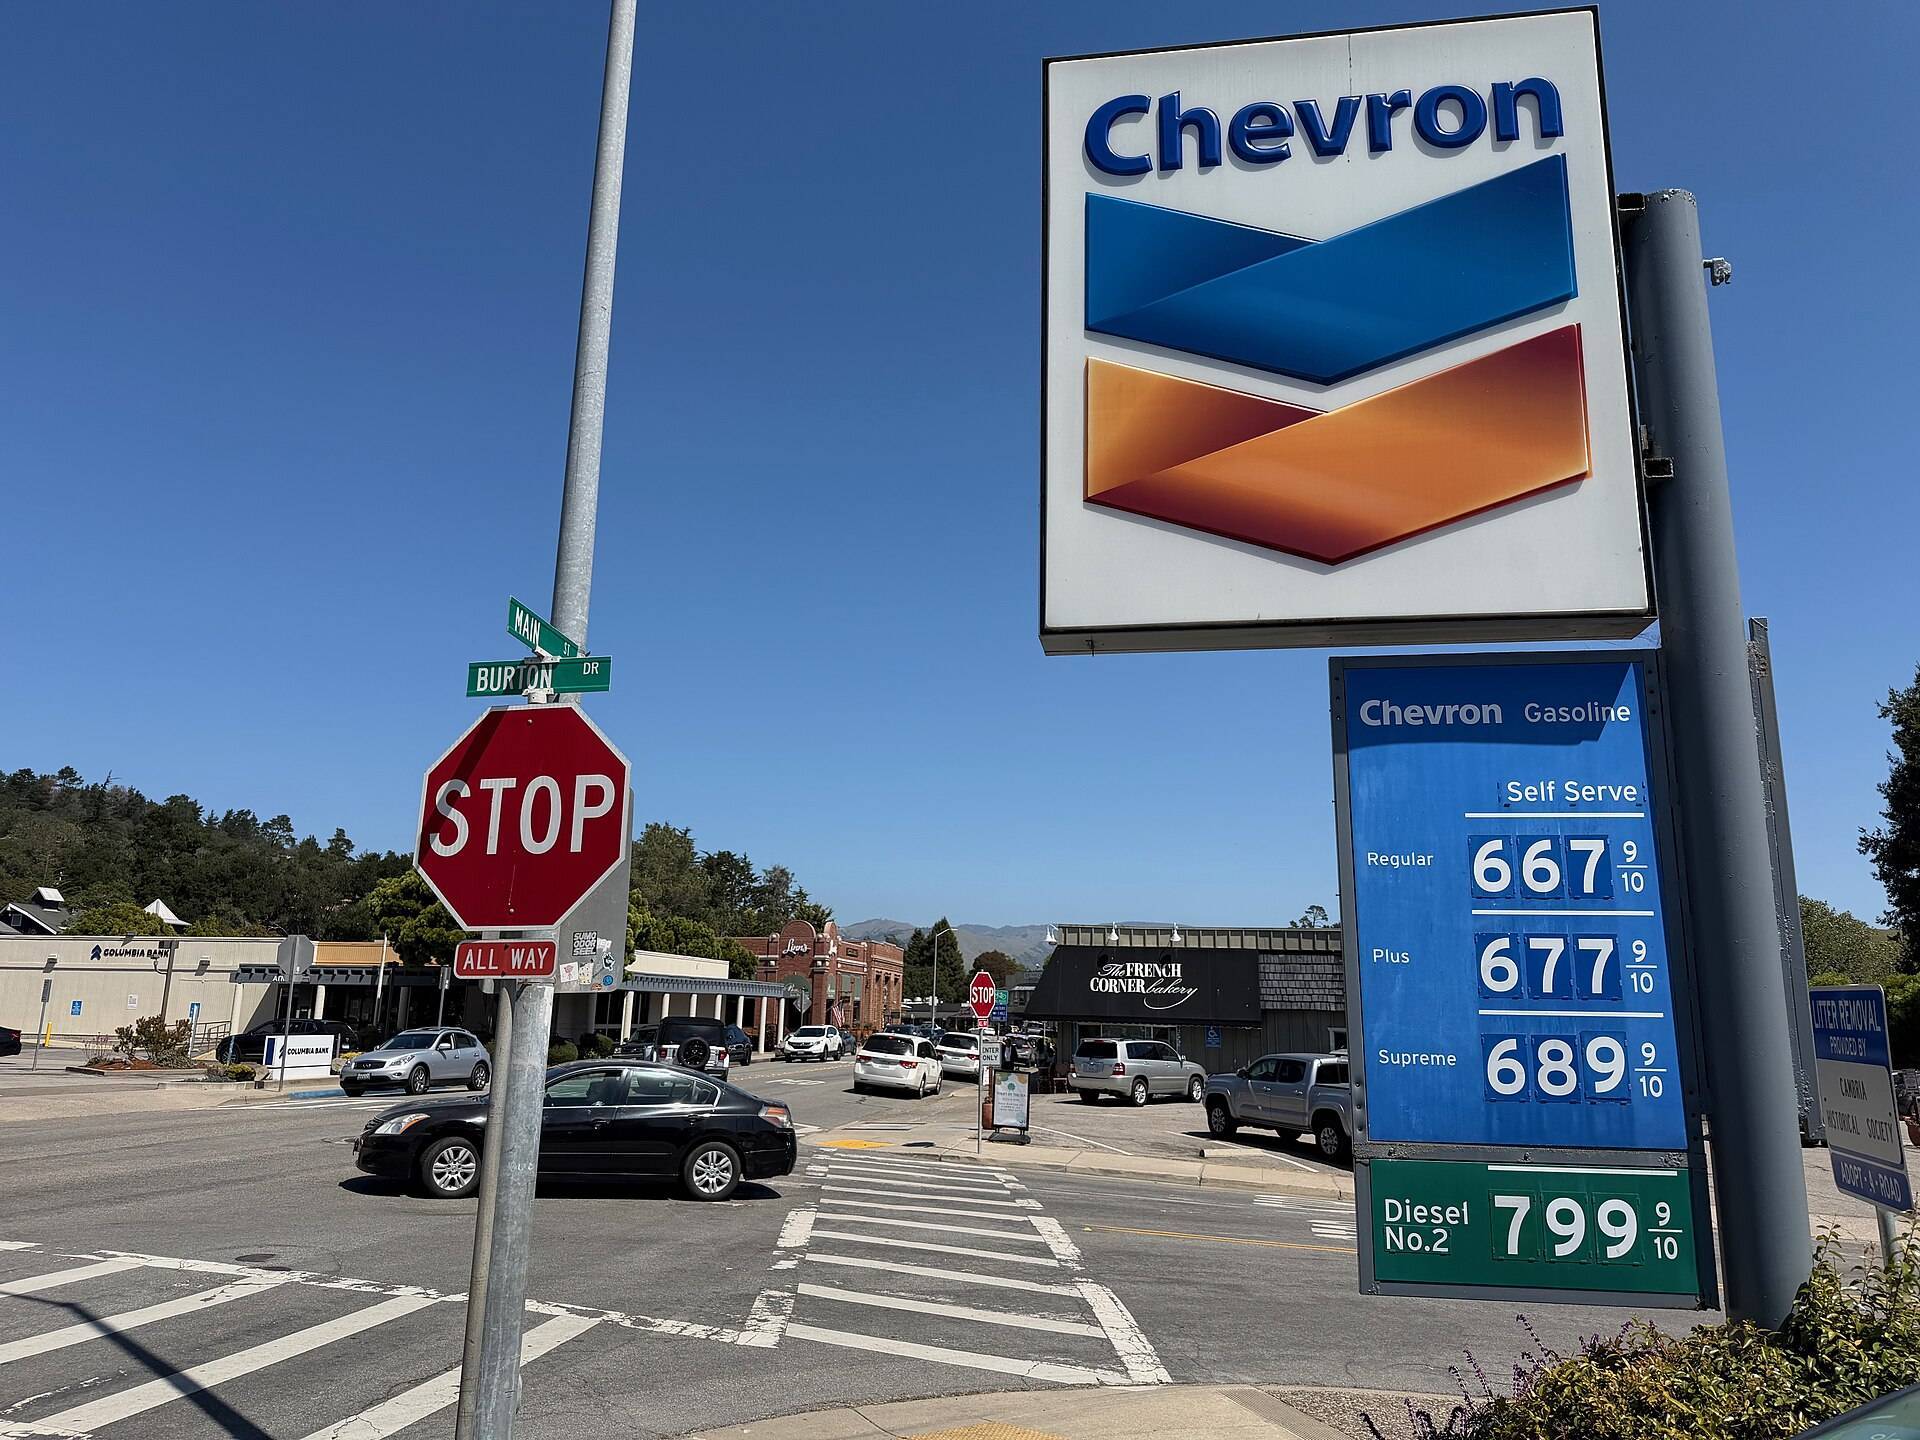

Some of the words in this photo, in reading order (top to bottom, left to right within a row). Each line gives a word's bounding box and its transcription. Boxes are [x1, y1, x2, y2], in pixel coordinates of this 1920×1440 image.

[1084, 75, 1564, 176] Chevron
[514, 607, 541, 646] MAIN
[563, 642, 571, 656] ST
[476, 663, 553, 692] BURTON
[583, 662, 599, 675] DR
[1359, 699, 1503, 726] Chevron
[1523, 701, 1631, 723] Gasoline
[1506, 780, 1555, 803] Self
[1564, 781, 1638, 802] Serve
[429, 774, 616, 857] STOP
[1367, 852, 1433, 871] Regular
[1623, 840, 1638, 863] 9
[1472, 838, 1606, 894] 667
[1621, 871, 1645, 893] 10
[573, 931, 597, 941] SUMO
[103, 948, 145, 958] COLUMBIA
[462, 947, 499, 971] ALL
[510, 947, 550, 971] WAY
[1372, 948, 1410, 963] Plus
[1632, 940, 1647, 963] 9
[1098, 963, 1125, 977] The
[1125, 962, 1183, 978] FRENCH
[1480, 937, 1614, 994] 677
[972, 986, 994, 1004] STOP
[1089, 977, 1146, 994] CORNER
[1143, 978, 1198, 1010] bakery
[1630, 972, 1654, 994] 10
[1811, 1000, 1839, 1029] LITTER
[1839, 1000, 1881, 1032] REMOVAL
[287, 1047, 315, 1055] COLUMBIA
[315, 1047, 329, 1055] BANK
[1641, 1042, 1657, 1066] 9
[1829, 1035, 1857, 1056] PROVIDED
[1857, 1038, 1867, 1057] BY
[1378, 1049, 1458, 1068] Supreme
[1486, 1036, 1626, 1096] 689
[1639, 1075, 1664, 1098] 10
[1839, 1077, 1868, 1101] CAMBRIA
[1826, 1109, 1861, 1135] HISTORICAL
[1866, 1118, 1894, 1144] SOCIETY
[1384, 1198, 1469, 1225] Diesel
[1655, 1201, 1671, 1226] 9
[1493, 1194, 1638, 1259] 799
[1385, 1226, 1449, 1253] No.2
[1653, 1236, 1678, 1260] 10
